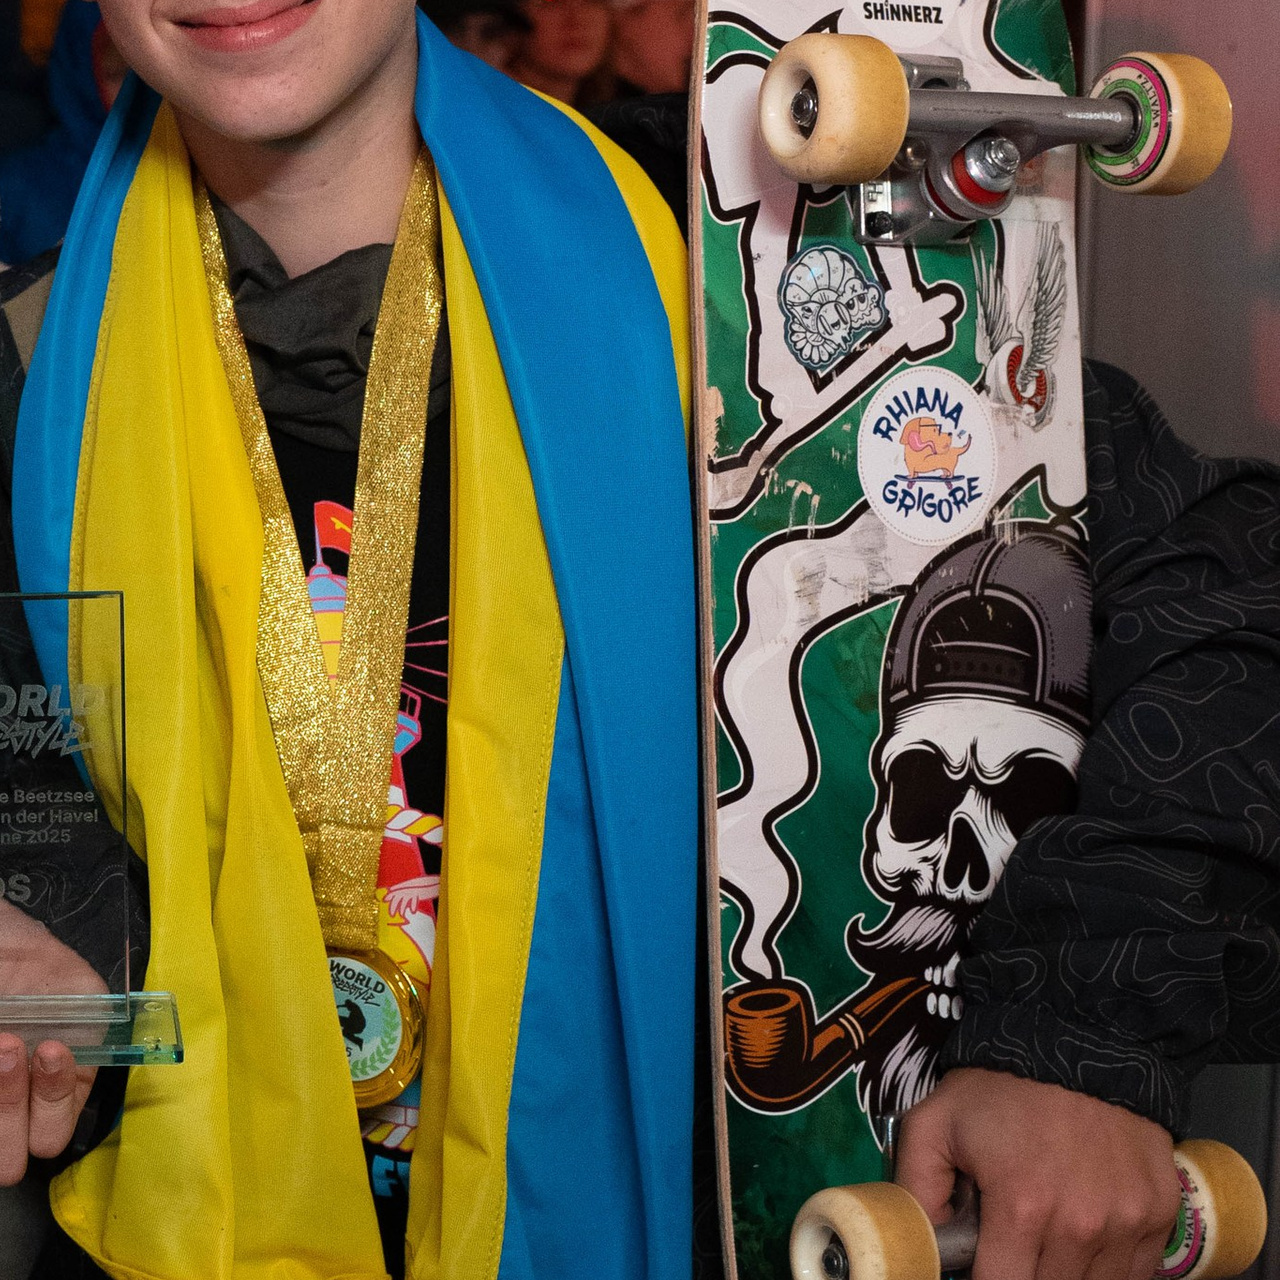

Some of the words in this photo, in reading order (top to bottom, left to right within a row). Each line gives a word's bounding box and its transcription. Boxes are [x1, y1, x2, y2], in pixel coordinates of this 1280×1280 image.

[1140, 79, 1160, 120] WALTZ
[873, 387, 963, 442] RHIANA
[883, 477, 983, 523] GRIGORE
[14, 789, 95, 804] Beetzsee
[15, 809, 45, 824] der
[49, 809, 98, 823] Havel
[26, 829, 71, 843] 2025
[330, 960, 385, 994] WORLD
